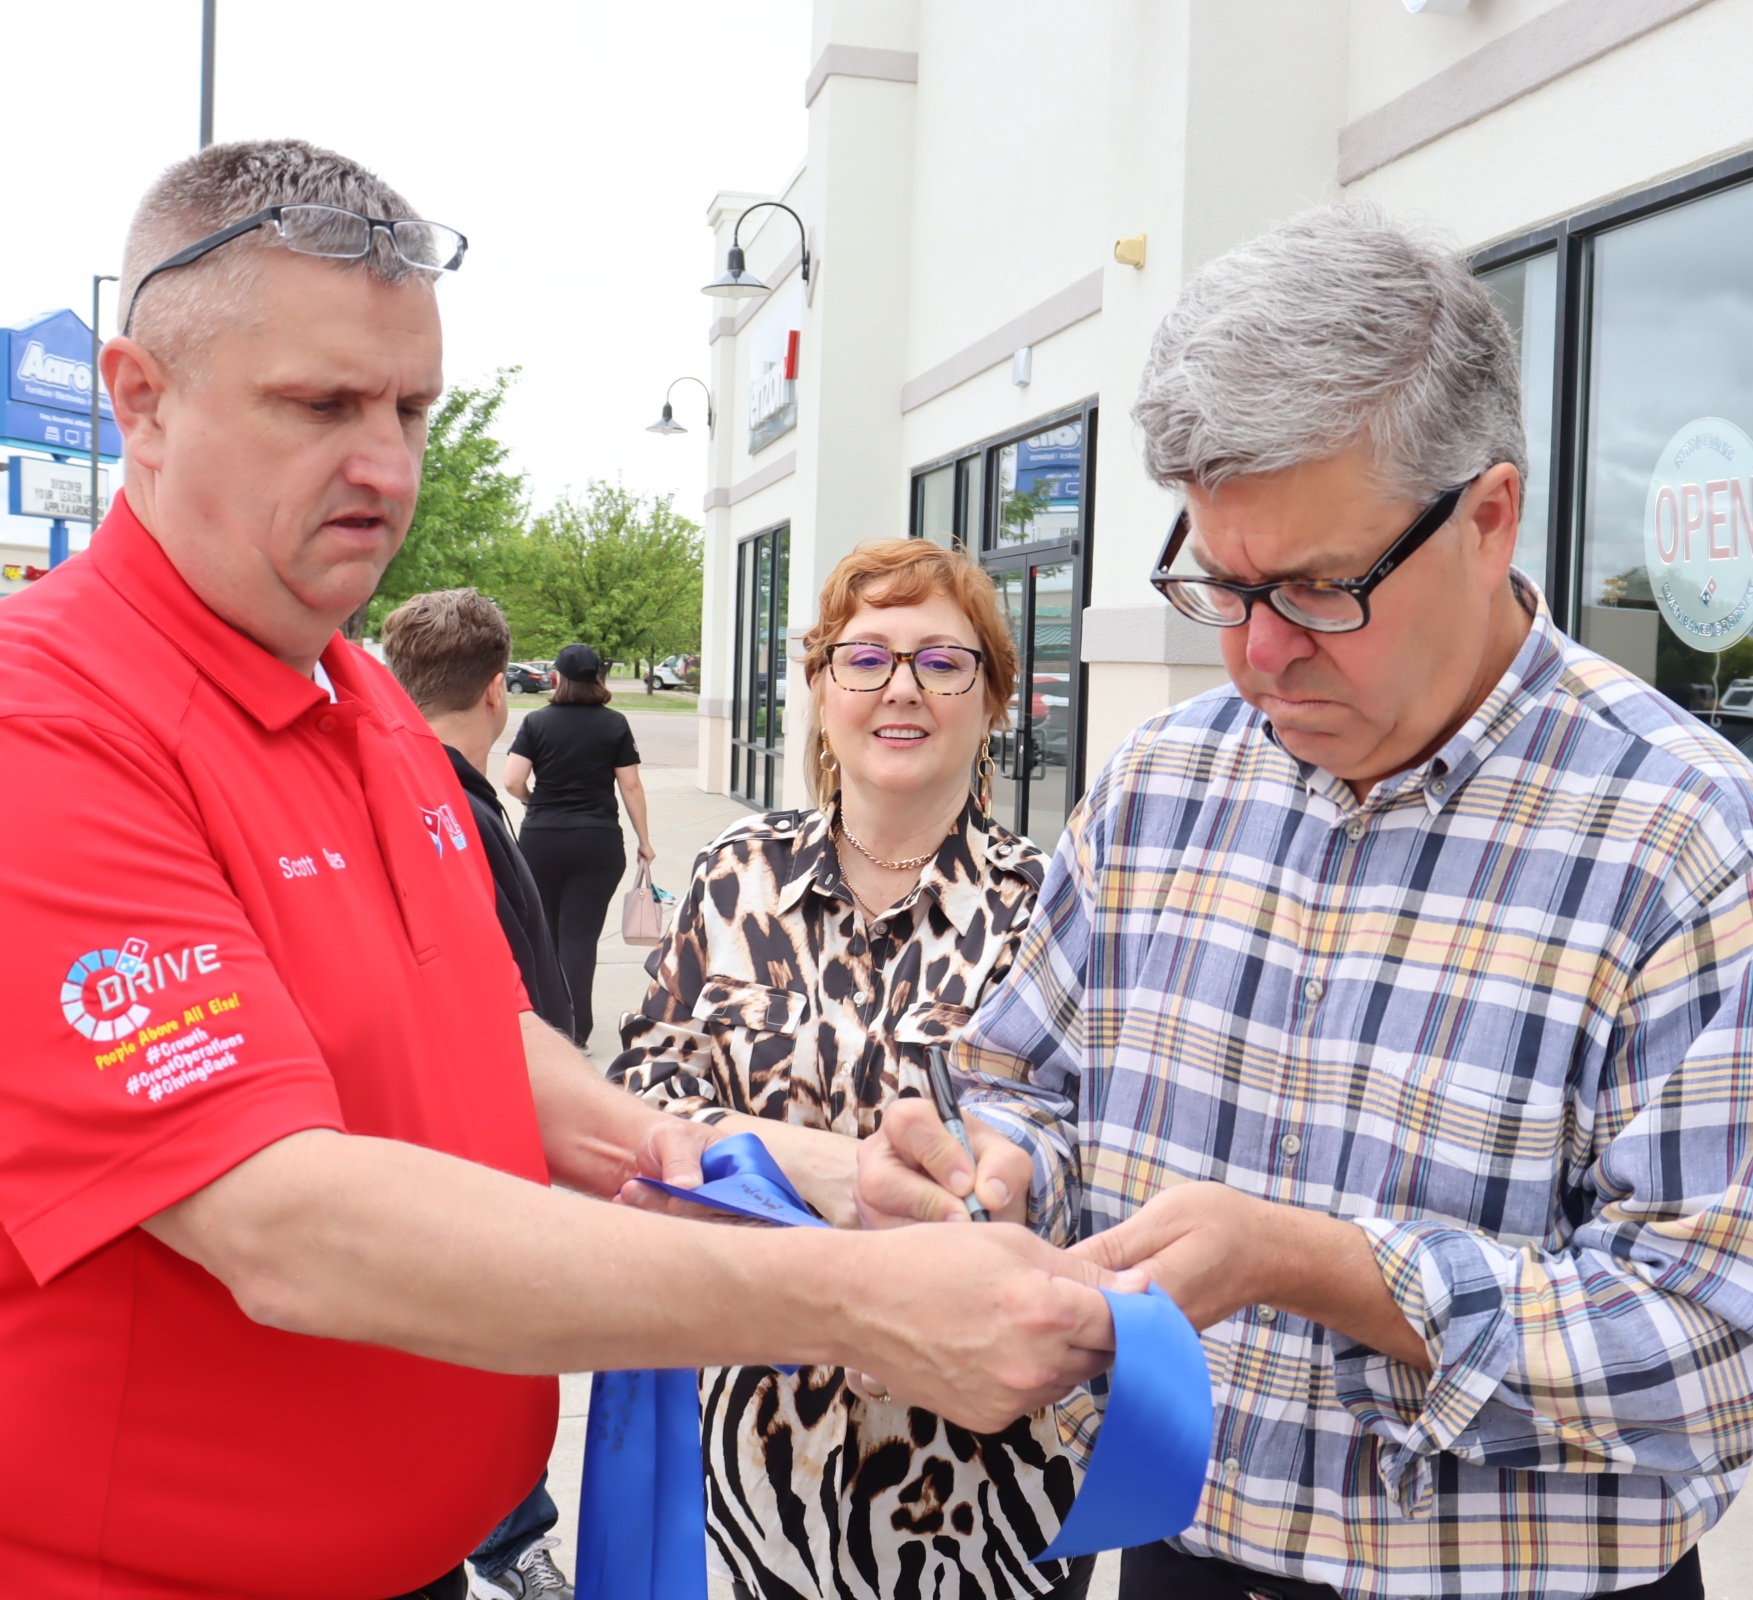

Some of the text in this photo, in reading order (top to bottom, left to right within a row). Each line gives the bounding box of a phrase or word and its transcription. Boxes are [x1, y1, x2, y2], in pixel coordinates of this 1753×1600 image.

[51, 479, 82, 492] DISCOVER
[1655, 476, 1753, 565] OPEN
[1683, 613, 1712, 636] BAKED
[279, 855, 318, 879] Scott
[97, 944, 222, 1012] DRIVE
[95, 992, 240, 1070] People Above All Else!
[146, 1027, 209, 1065] #Growth
